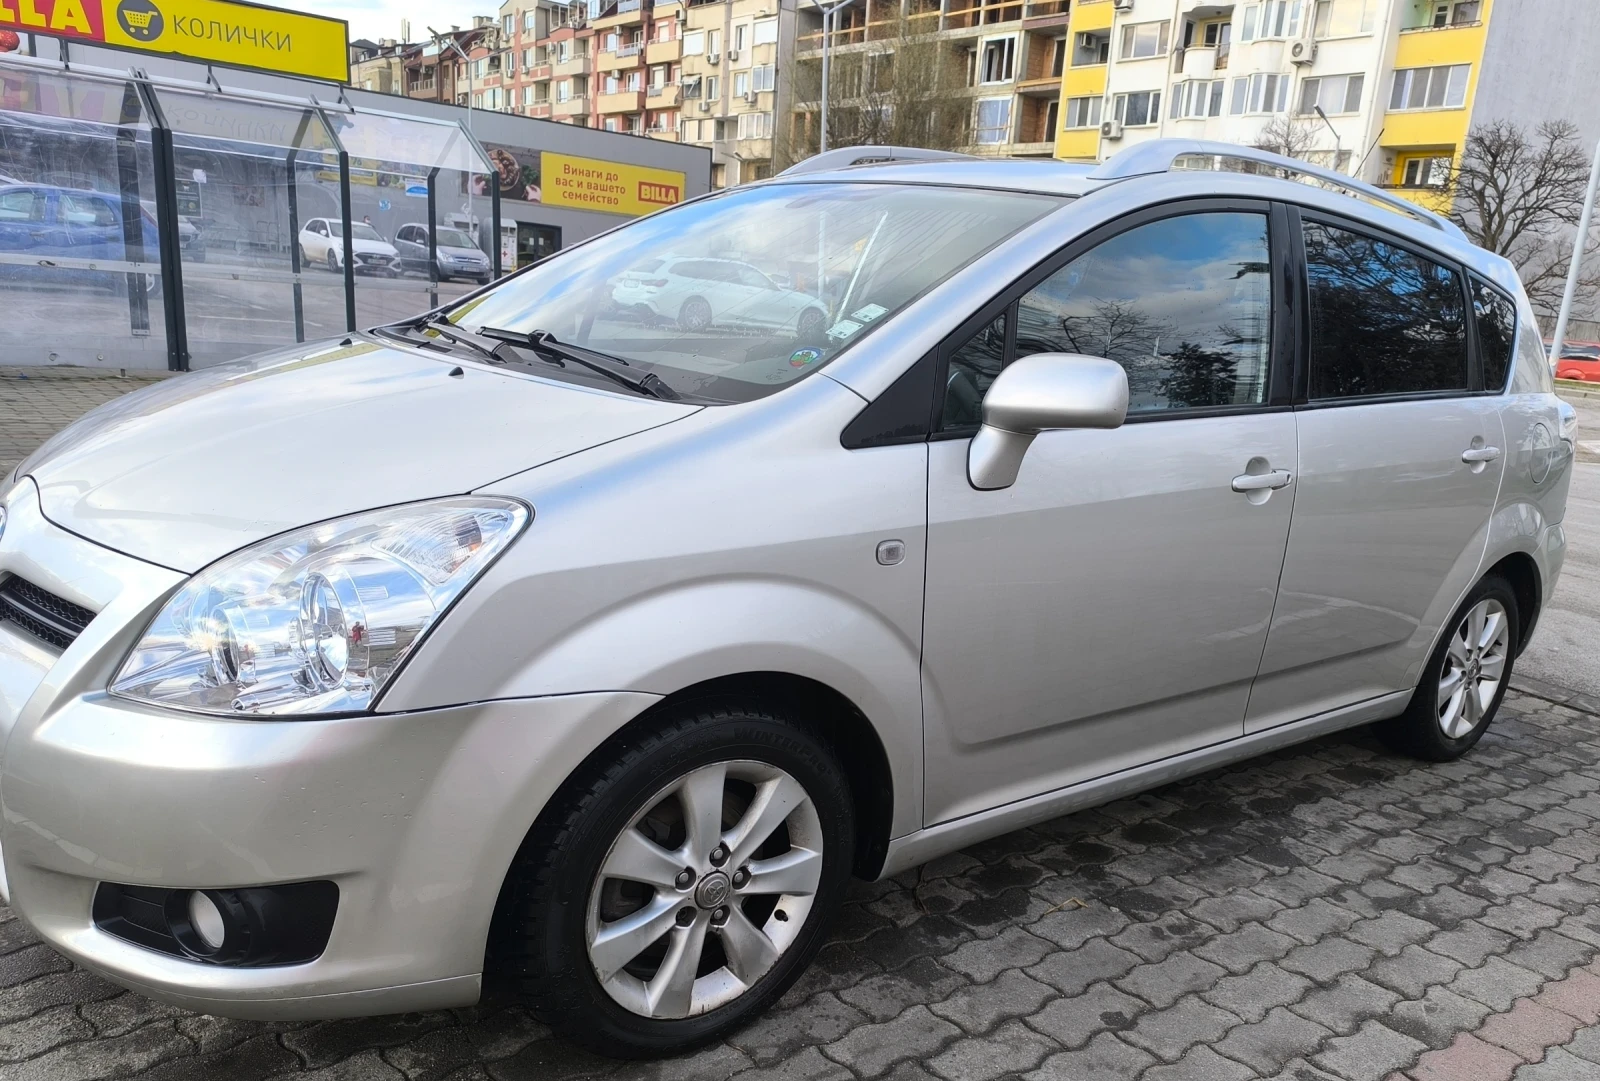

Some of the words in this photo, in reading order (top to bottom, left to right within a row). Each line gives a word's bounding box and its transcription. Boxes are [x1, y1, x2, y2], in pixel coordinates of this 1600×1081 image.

[173, 14, 291, 52] КОЛИЧКИ
[563, 163, 603, 179] Винаги
[605, 172, 619, 182] до
[555, 177, 574, 188] вас
[576, 180, 583, 189] и
[586, 181, 626, 194] вашето
[640, 184, 677, 204] BILLA
[562, 190, 619, 206] семейство
